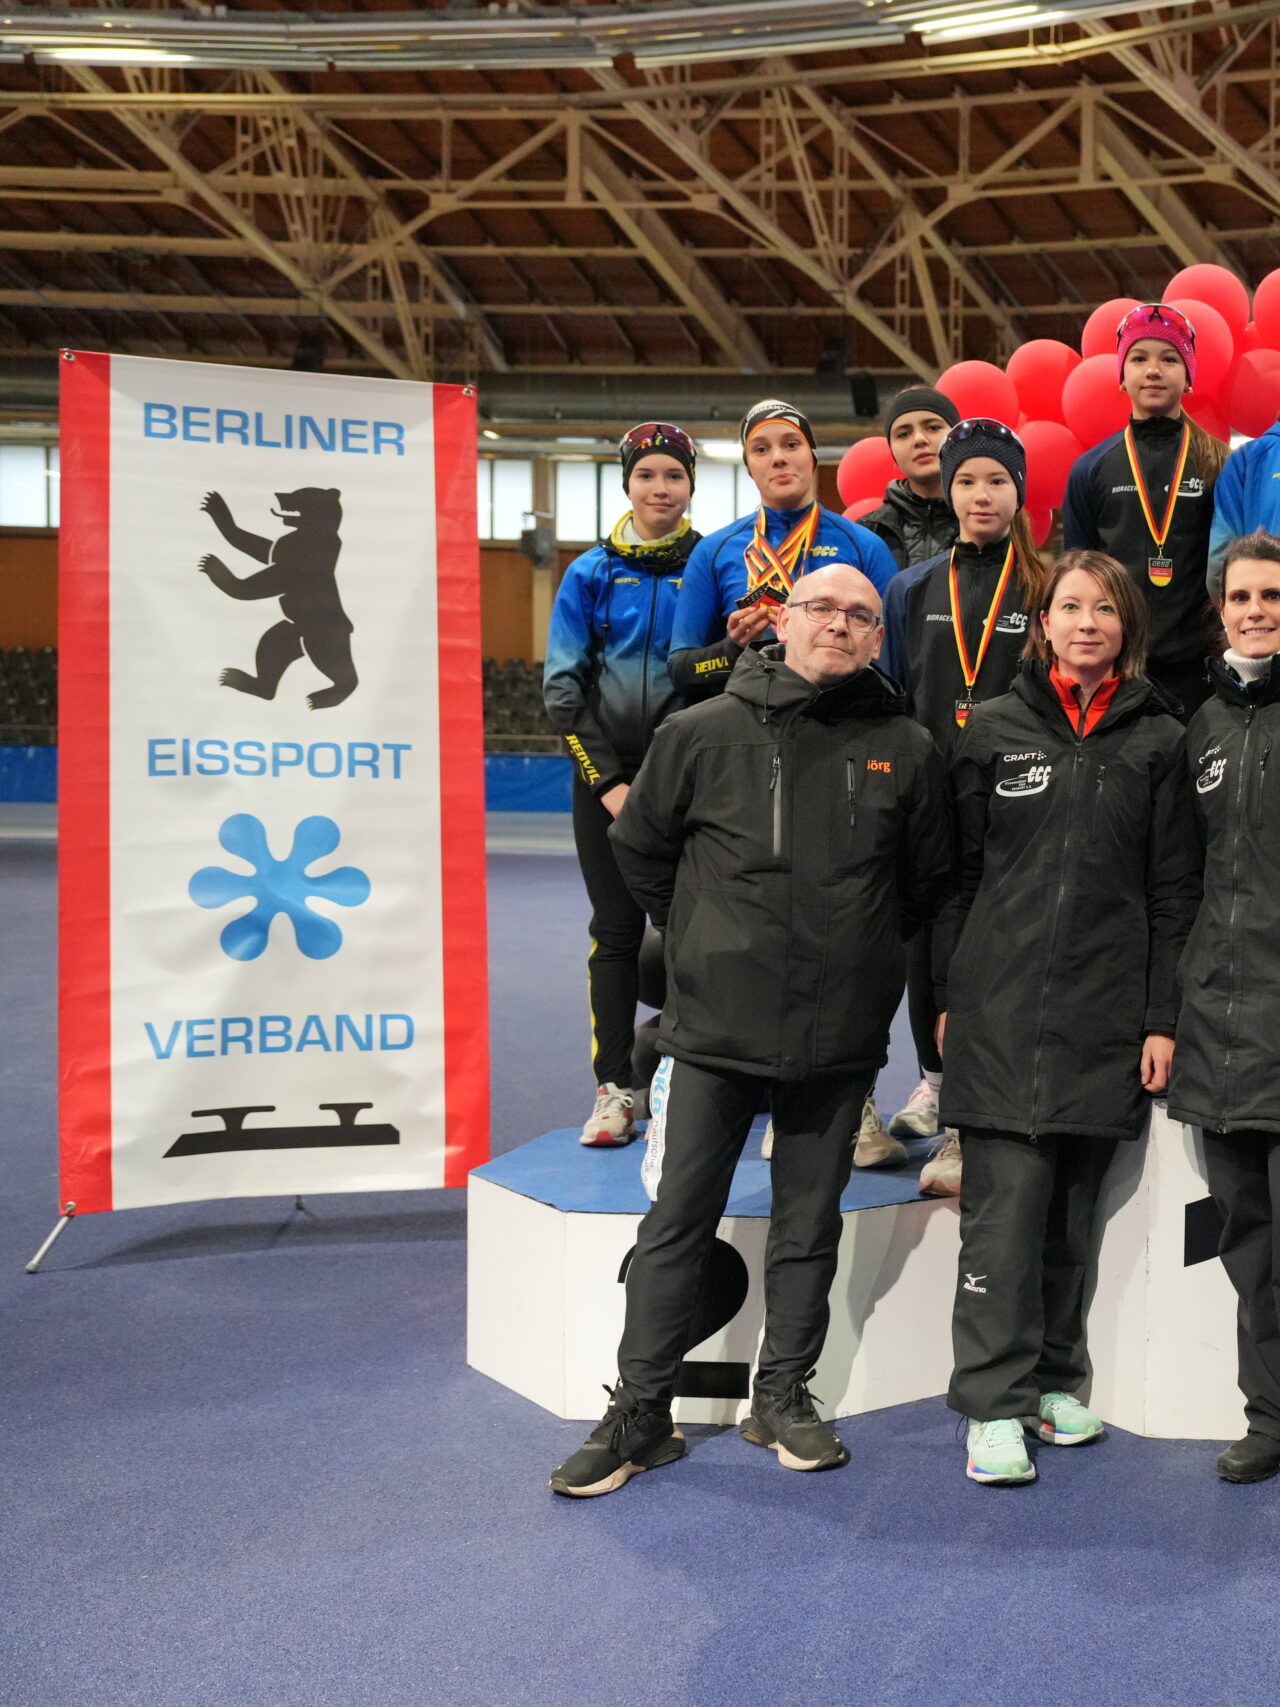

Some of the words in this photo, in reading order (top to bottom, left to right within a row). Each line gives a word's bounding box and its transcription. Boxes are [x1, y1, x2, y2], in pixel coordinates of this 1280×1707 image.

[144, 402, 405, 456] BERLINER
[148, 738, 412, 779] EISSPORT
[565, 734, 600, 785] REDVIL
[1003, 752, 1037, 762] CRAFT
[144, 1013, 415, 1060] VERBAND
